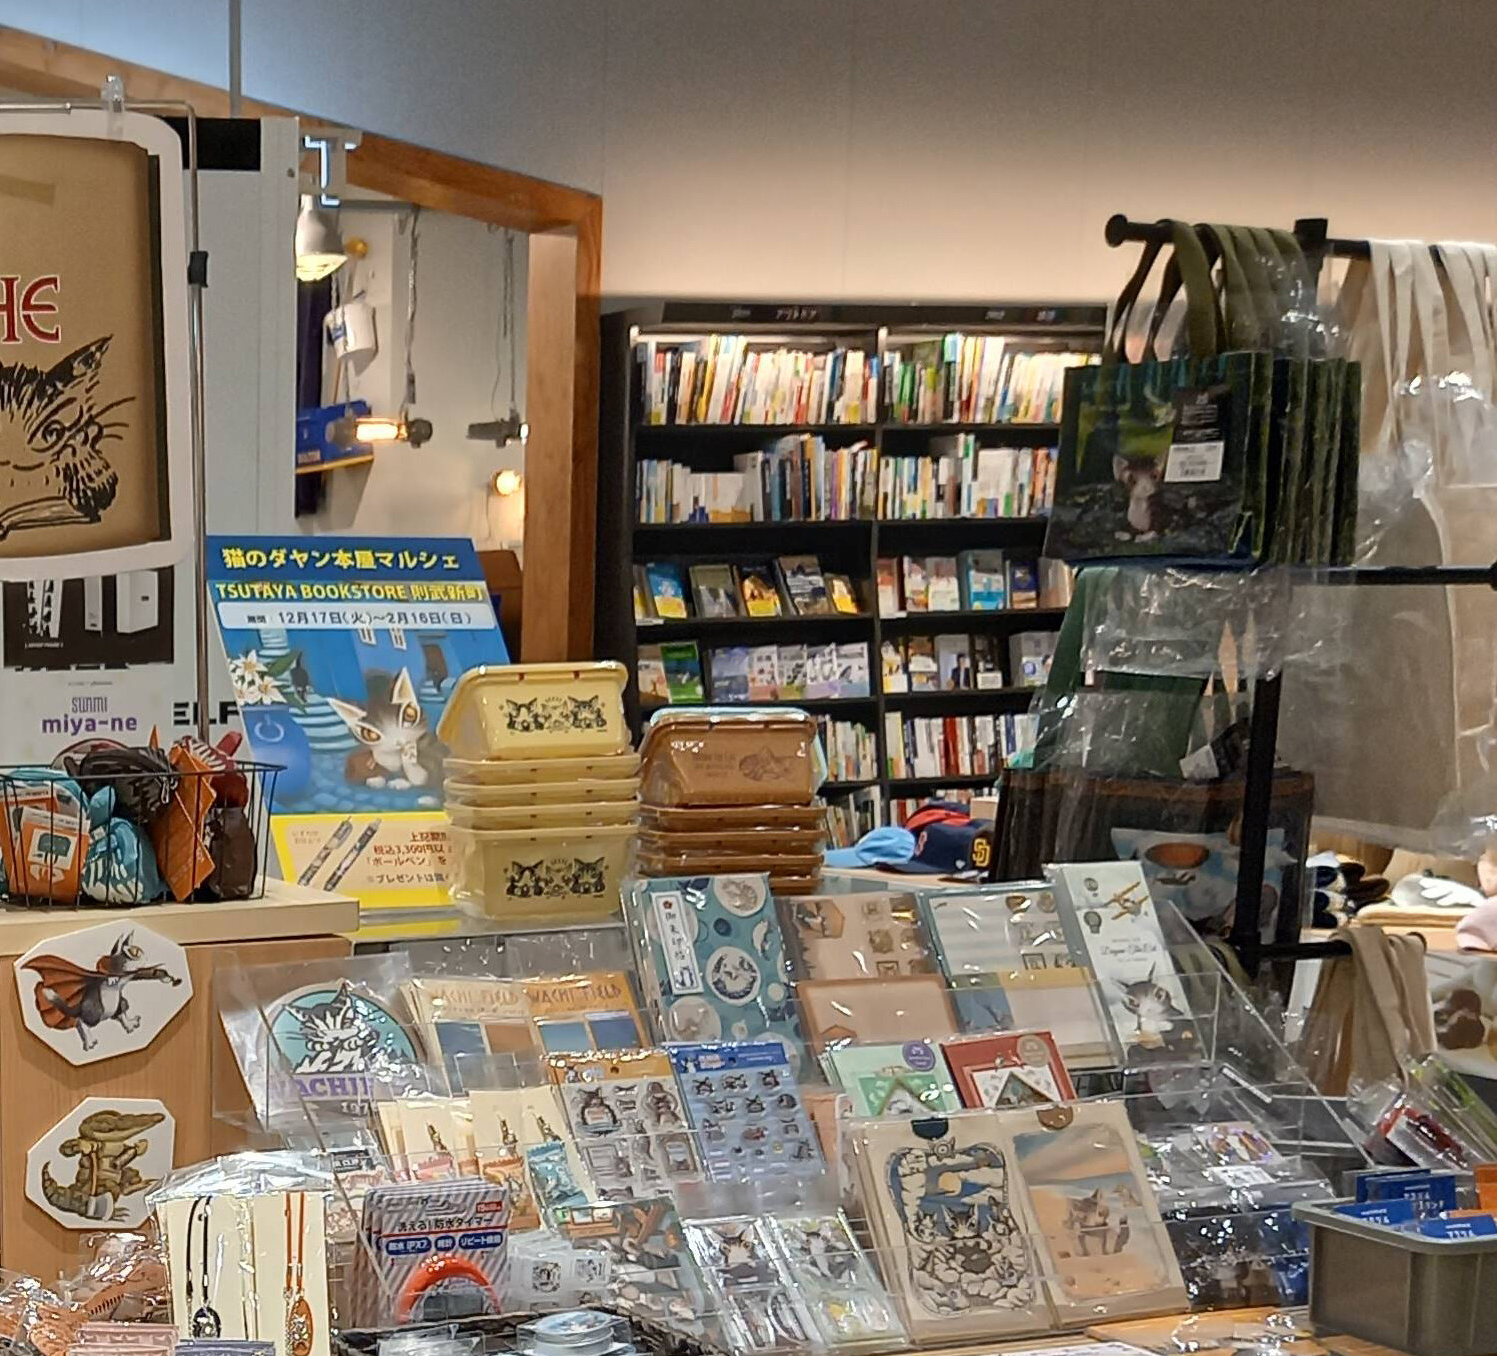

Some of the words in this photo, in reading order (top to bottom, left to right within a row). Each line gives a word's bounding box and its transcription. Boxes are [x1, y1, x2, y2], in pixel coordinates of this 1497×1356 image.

[222, 547, 461, 571] 猫のダヤン本屋マルシェ
[215, 583, 297, 599] TSUTAYA
[302, 584, 407, 600] BOOKSTORE
[42, 713, 138, 736] miya-ne
